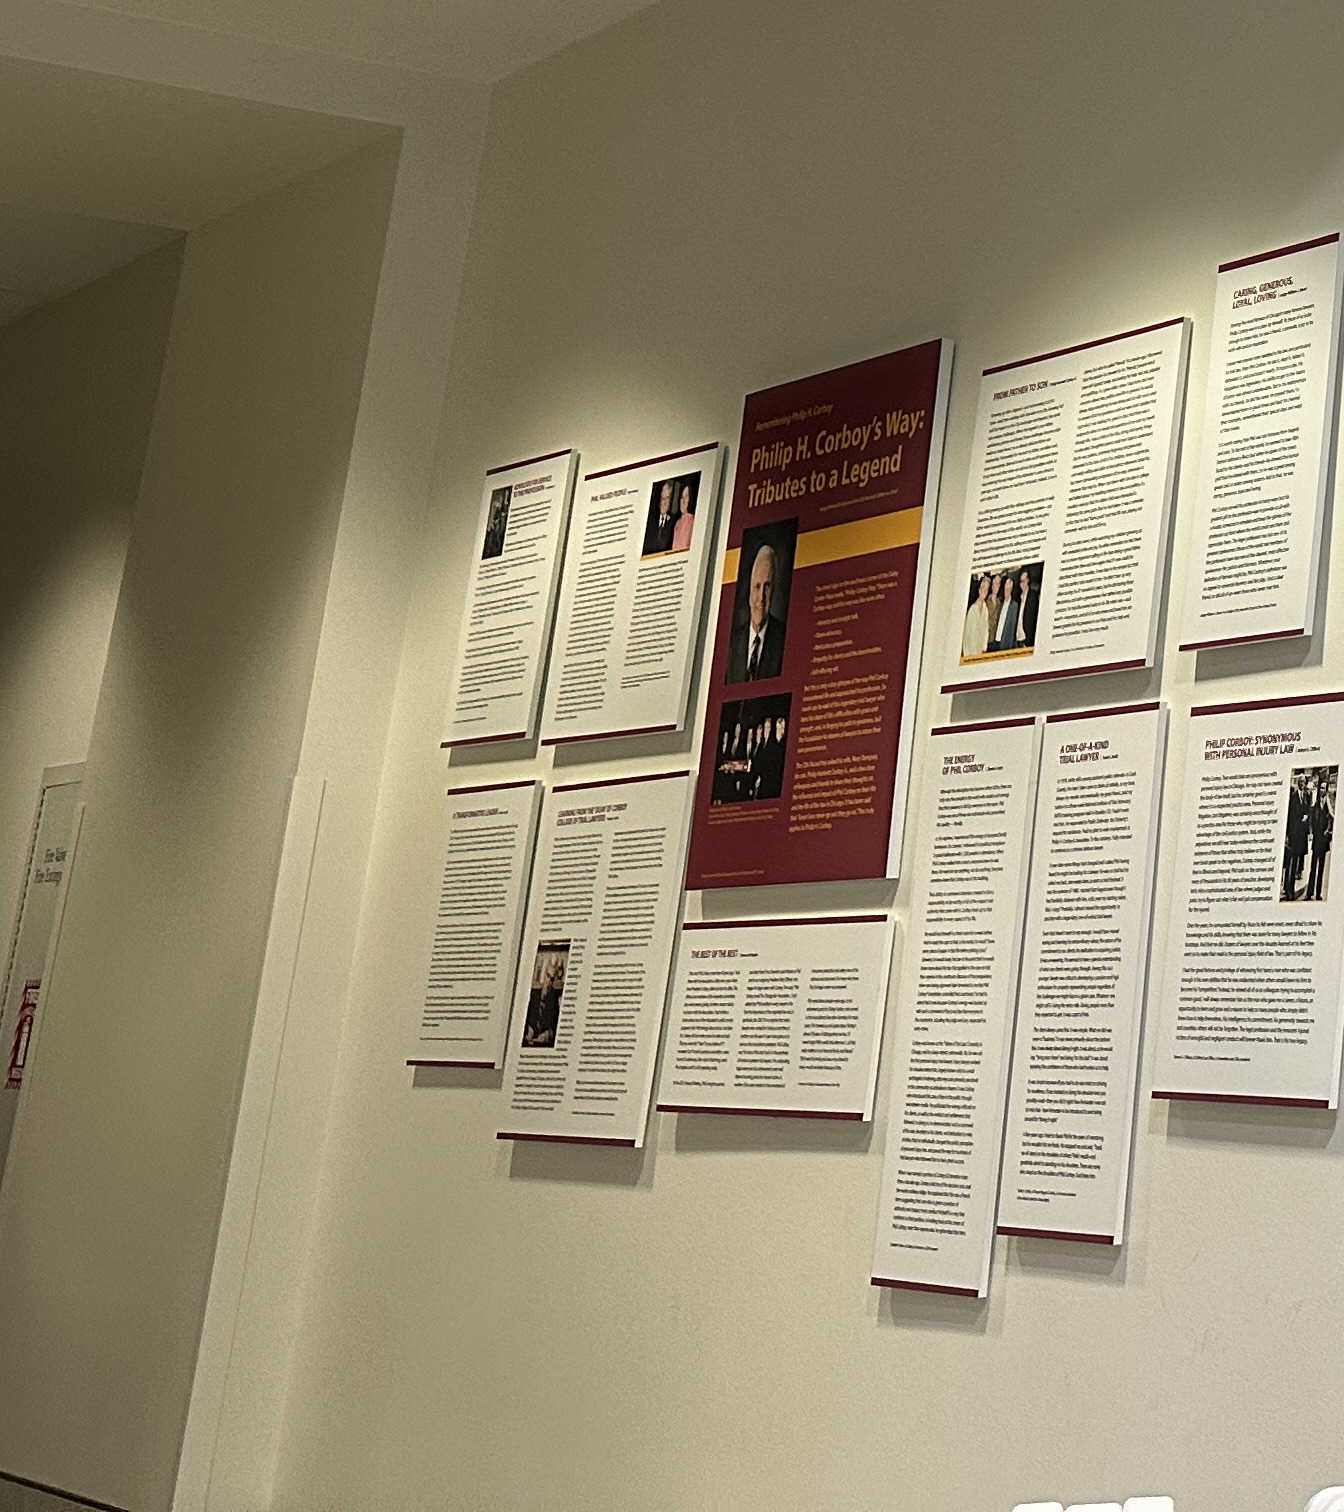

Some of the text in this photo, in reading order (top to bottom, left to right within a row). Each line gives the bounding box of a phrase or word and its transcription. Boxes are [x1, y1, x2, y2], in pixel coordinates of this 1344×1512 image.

[751, 409, 925, 473] Philip H. Corboy's Way:
[748, 477, 806, 509] Tributes
[810, 470, 826, 493] to
[829, 473, 838, 488] a
[841, 445, 903, 488] Legend
